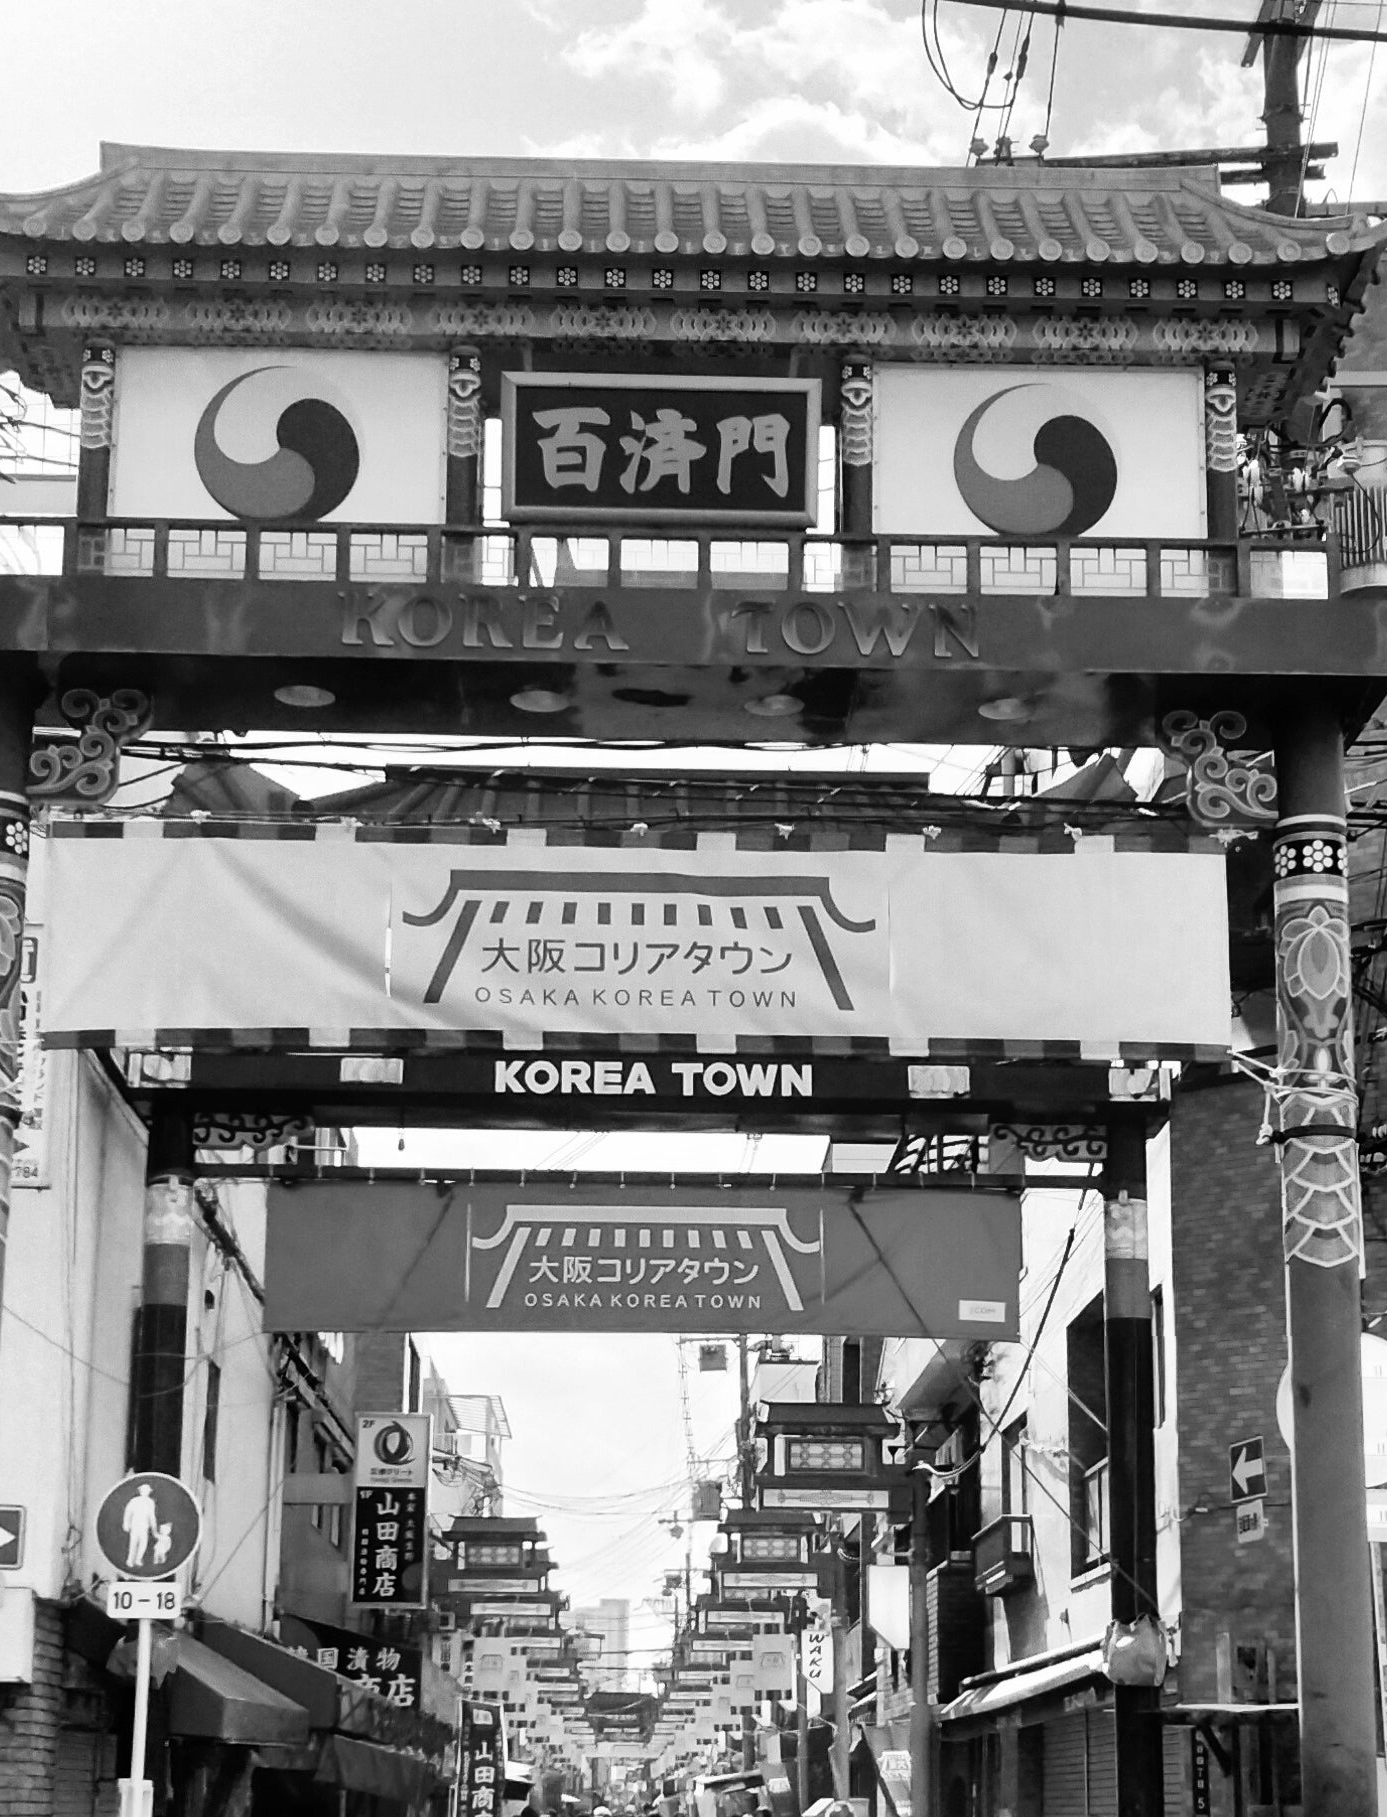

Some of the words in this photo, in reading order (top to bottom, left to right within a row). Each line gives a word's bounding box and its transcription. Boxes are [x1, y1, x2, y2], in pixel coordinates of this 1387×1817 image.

[532, 407, 790, 498] 百済門
[339, 592, 629, 650] KOREA
[731, 600, 980, 658] TOWN
[481, 938, 792, 975] 大阪コリアタウン
[475, 987, 579, 1006] OSAKA
[593, 989, 696, 1007] KOREA
[707, 990, 796, 1008] TOWN
[494, 1060, 656, 1095] KOREA
[671, 1061, 812, 1097] TOWN
[529, 1255, 759, 1284] 大阪コリアタウン
[524, 1293, 602, 1307] OSAKA
[611, 1294, 688, 1308] KOREA
[694, 1295, 761, 1309] TOWN
[372, 1491, 400, 1597] 山田商店
[809, 1634, 825, 1678] WAKU
[472, 1741, 495, 1817] 山田商
